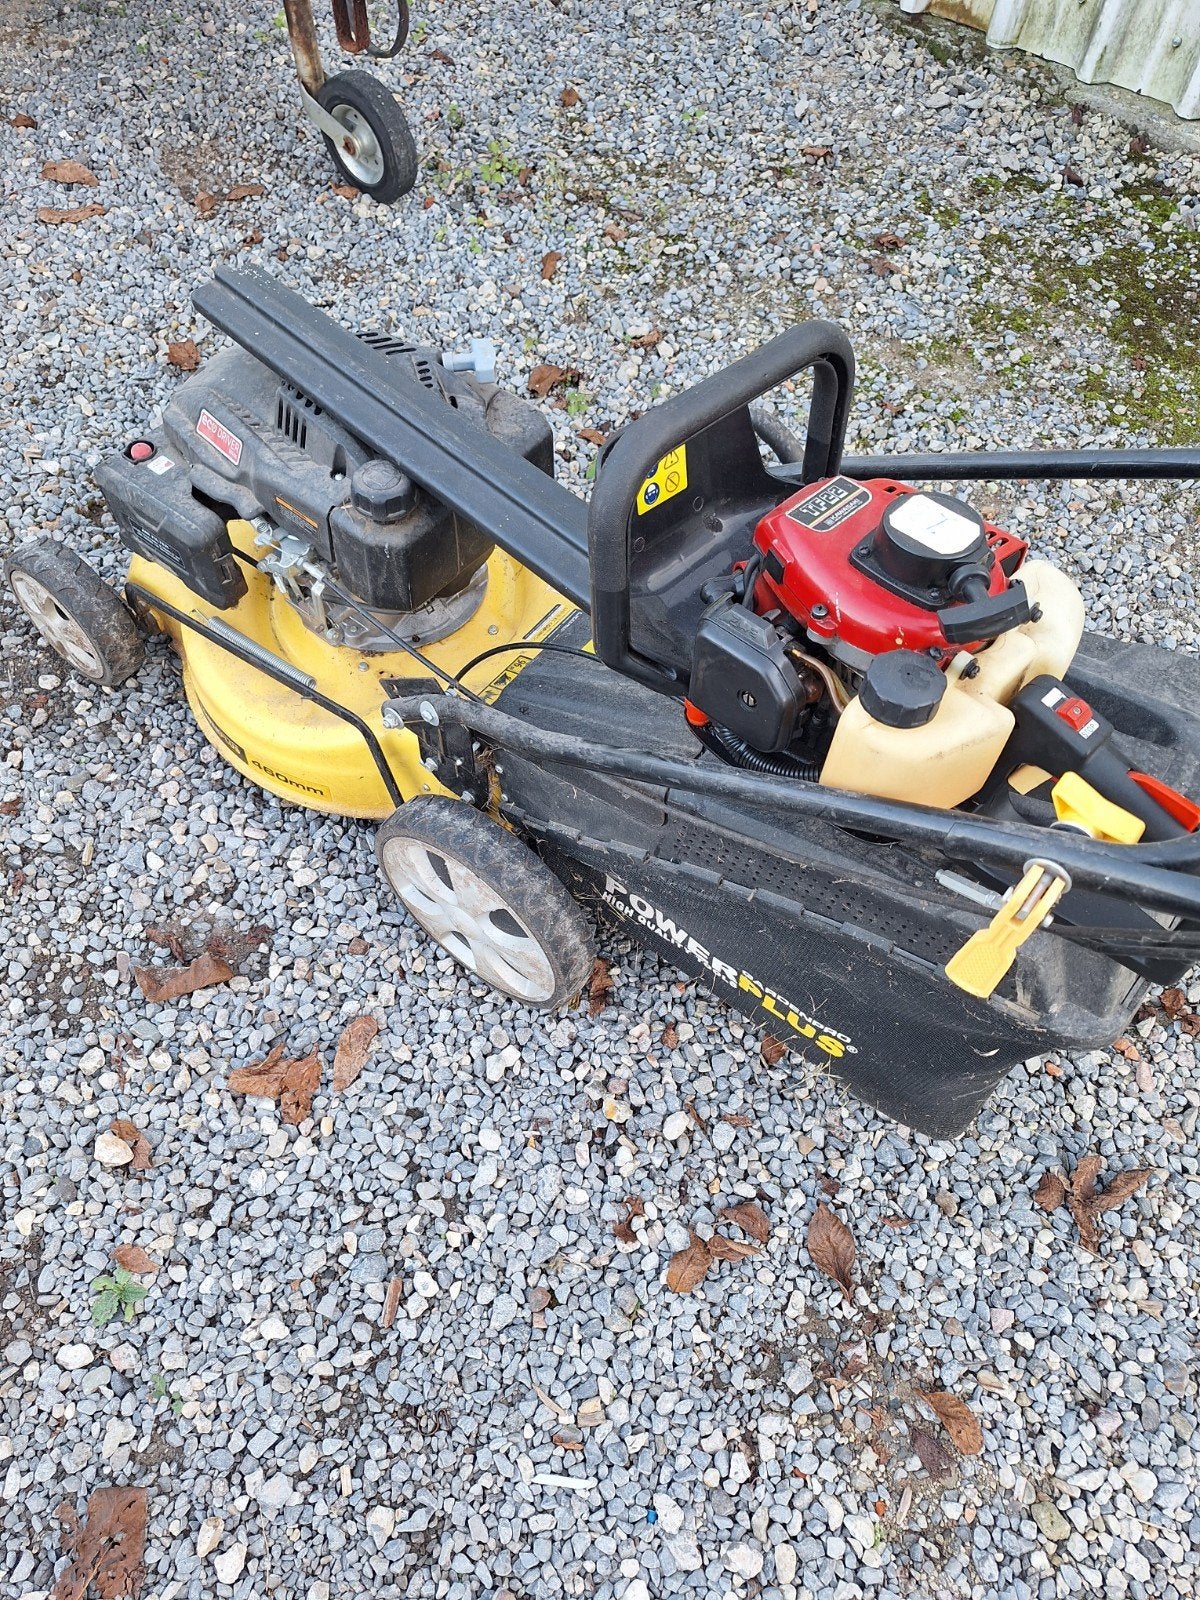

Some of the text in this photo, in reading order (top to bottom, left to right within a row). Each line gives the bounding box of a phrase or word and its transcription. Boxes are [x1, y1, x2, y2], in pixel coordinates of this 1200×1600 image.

[216, 427, 240, 454] DRIVER
[799, 486, 849, 517] TF22
[1081, 723, 1095, 738] STOP
[251, 759, 324, 796] 460mm
[602, 891, 635, 917] HIGH
[638, 915, 691, 954] QUALITY
[741, 969, 852, 1044] GARDENPRO
